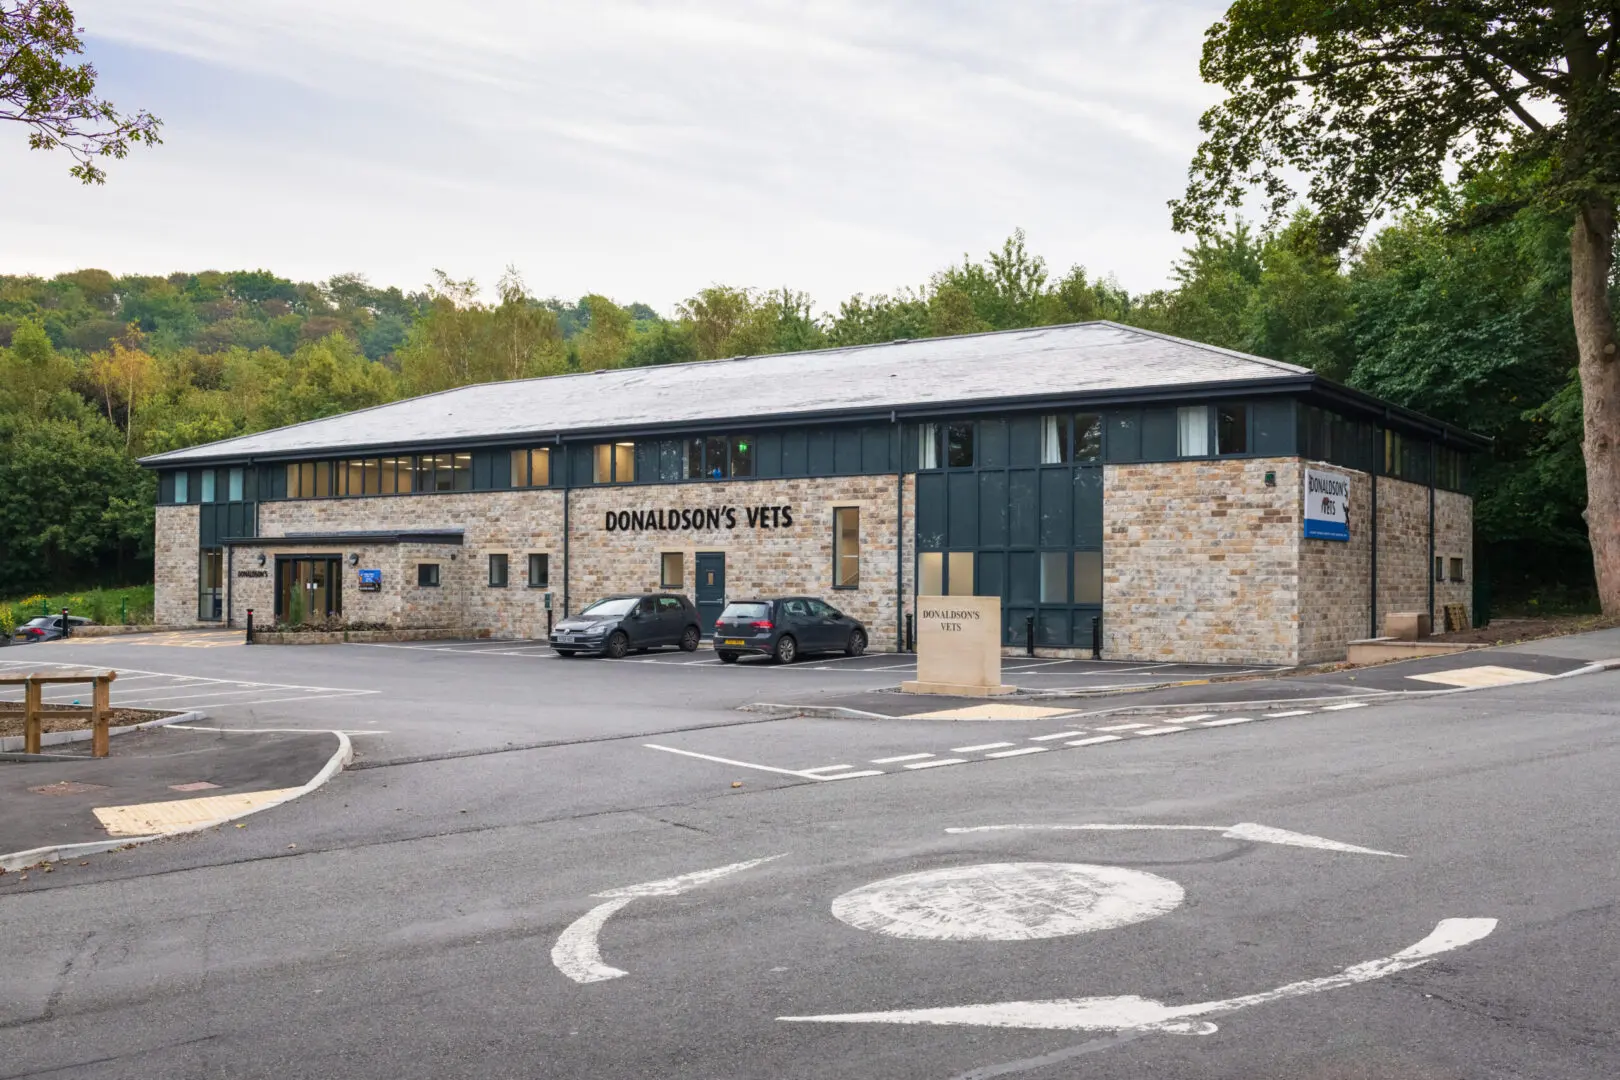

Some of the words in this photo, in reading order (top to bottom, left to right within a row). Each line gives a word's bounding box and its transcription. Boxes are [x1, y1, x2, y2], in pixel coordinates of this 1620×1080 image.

[1308, 478, 1348, 498] DONALDSON'S
[605, 506, 736, 532] DONALDSON'S
[746, 505, 793, 528] VETS
[237, 570, 268, 578] DONALDSON'S
[922, 610, 980, 620] DONALDSON'S
[941, 622, 962, 632] VETS
